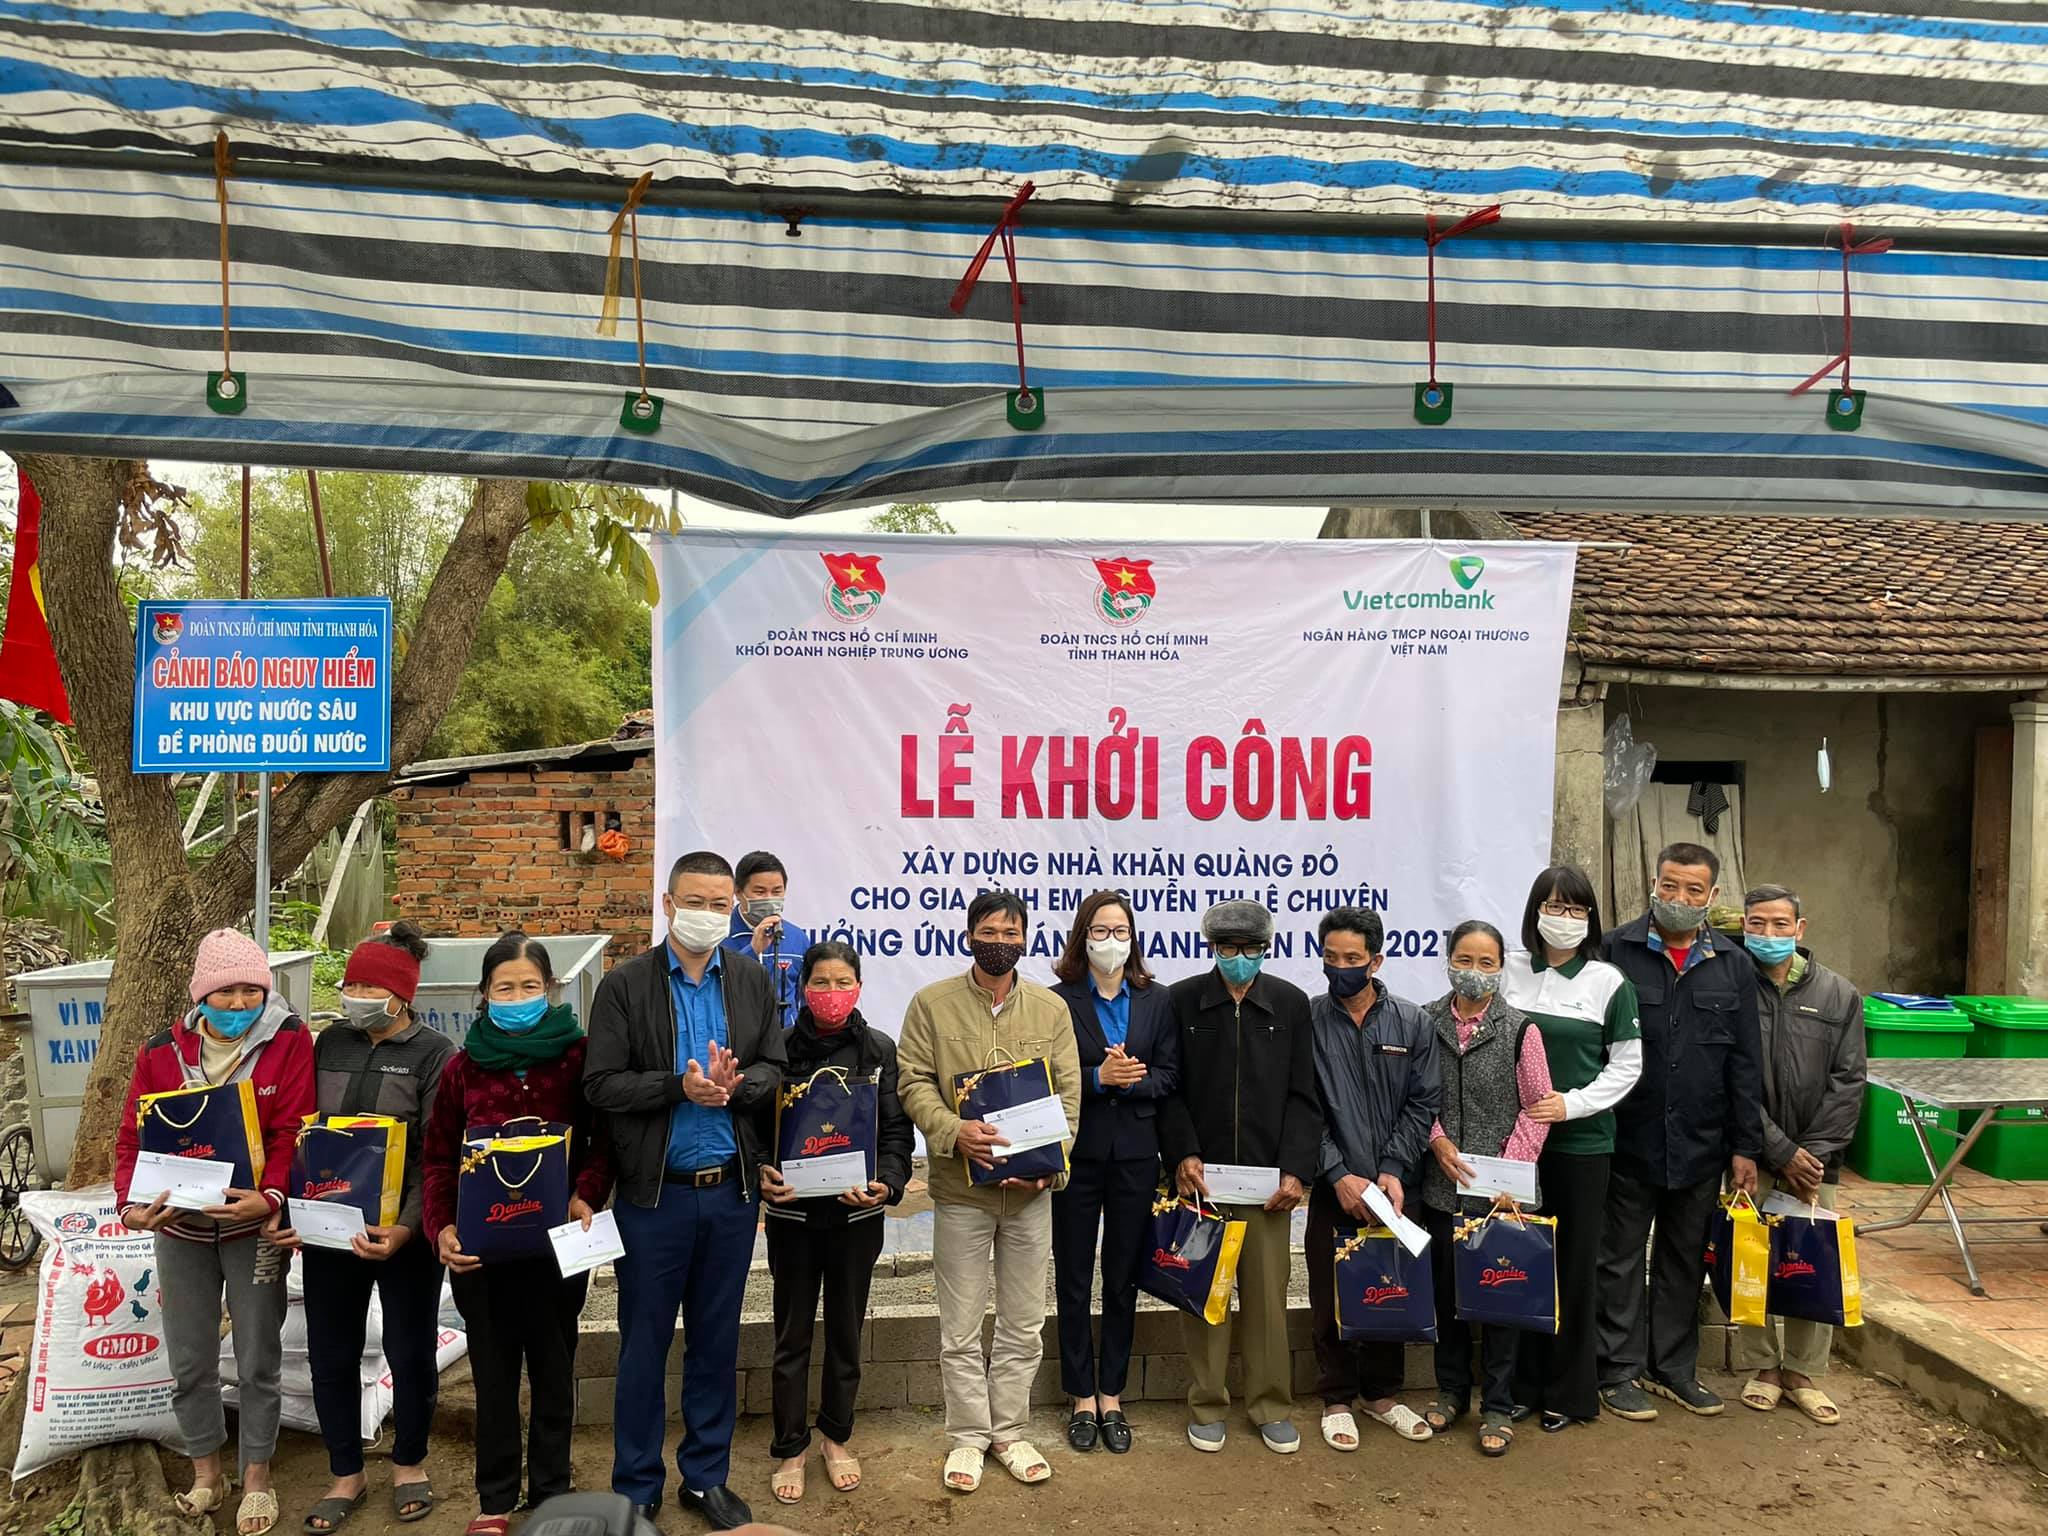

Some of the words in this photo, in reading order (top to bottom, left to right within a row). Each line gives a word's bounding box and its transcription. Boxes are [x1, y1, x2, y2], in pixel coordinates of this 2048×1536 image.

[1343, 589, 1496, 611] Vietcombank
[190, 618, 215, 637] ĐOÀN
[217, 622, 241, 637] TNCS
[242, 614, 257, 637] HỒ
[258, 617, 276, 637] CHÍ
[277, 622, 301, 637] MINH
[302, 617, 324, 637] TỈNH
[325, 622, 357, 637] THANH
[359, 618, 378, 637] HÓA
[767, 627, 807, 642] ĐOÀN
[812, 631, 846, 643] TNCS
[850, 626, 871, 643] HỒ
[874, 630, 899, 643] CHÍ
[903, 632, 938, 644] MINH
[1303, 627, 1343, 642] NGÂN
[1347, 627, 1388, 642] HÀNG
[1391, 629, 1427, 641] TMCP
[1430, 629, 1471, 644] NGOẠI
[1475, 629, 1530, 642] THƯƠNG
[1040, 631, 1079, 645] ĐOÀN
[1084, 634, 1117, 645] TNCS
[1121, 629, 1141, 645] HỒ
[1145, 631, 1169, 646] CHÍ
[1174, 634, 1209, 646] MINH
[735, 641, 769, 657] KHỐI
[774, 645, 823, 658] DOANH
[828, 645, 877, 661] NGHIỆP
[881, 647, 924, 659] TRUNG
[929, 647, 969, 659] ƯƠNG
[1068, 646, 1097, 660] TỈNH
[1102, 650, 1146, 661] THANH
[1150, 647, 1180, 661] HÓA
[1390, 642, 1415, 658] VIỆT
[1418, 644, 1448, 655] NAM
[153, 647, 211, 688] CẢNH
[214, 651, 257, 688] BÁO
[263, 656, 319, 688] NGUY
[322, 646, 376, 688] HIỂM
[169, 702, 209, 721] KHU
[215, 701, 253, 724] VỰC
[259, 698, 312, 721] NƯỚC
[318, 698, 357, 721] SÂU
[158, 728, 183, 754] ĐỀ
[188, 730, 256, 753] PHÒNG
[262, 727, 307, 753] ĐUỐI
[314, 731, 367, 753] NƯỚC
[901, 702, 974, 818] LỄ
[1001, 706, 1159, 820] KHỞI
[1186, 718, 1372, 821] CÔNG
[901, 844, 955, 875] XÂY
[963, 849, 1039, 882] DỰNG
[1047, 846, 1103, 876] NHÀ
[1112, 847, 1185, 876] KHĂN
[1194, 847, 1293, 878] QUÀNG
[1301, 844, 1339, 877] ĐỎ
[850, 887, 911, 910] CHO
[919, 887, 967, 910] GIA
[1048, 888, 1082, 911] EM
[58, 998, 79, 1026] VÌ
[800, 1132, 850, 1155] Danisa
[485, 1199, 542, 1223] Danisa
[1478, 1266, 1527, 1287] Danisa
[1361, 1284, 1408, 1305] Danisa
